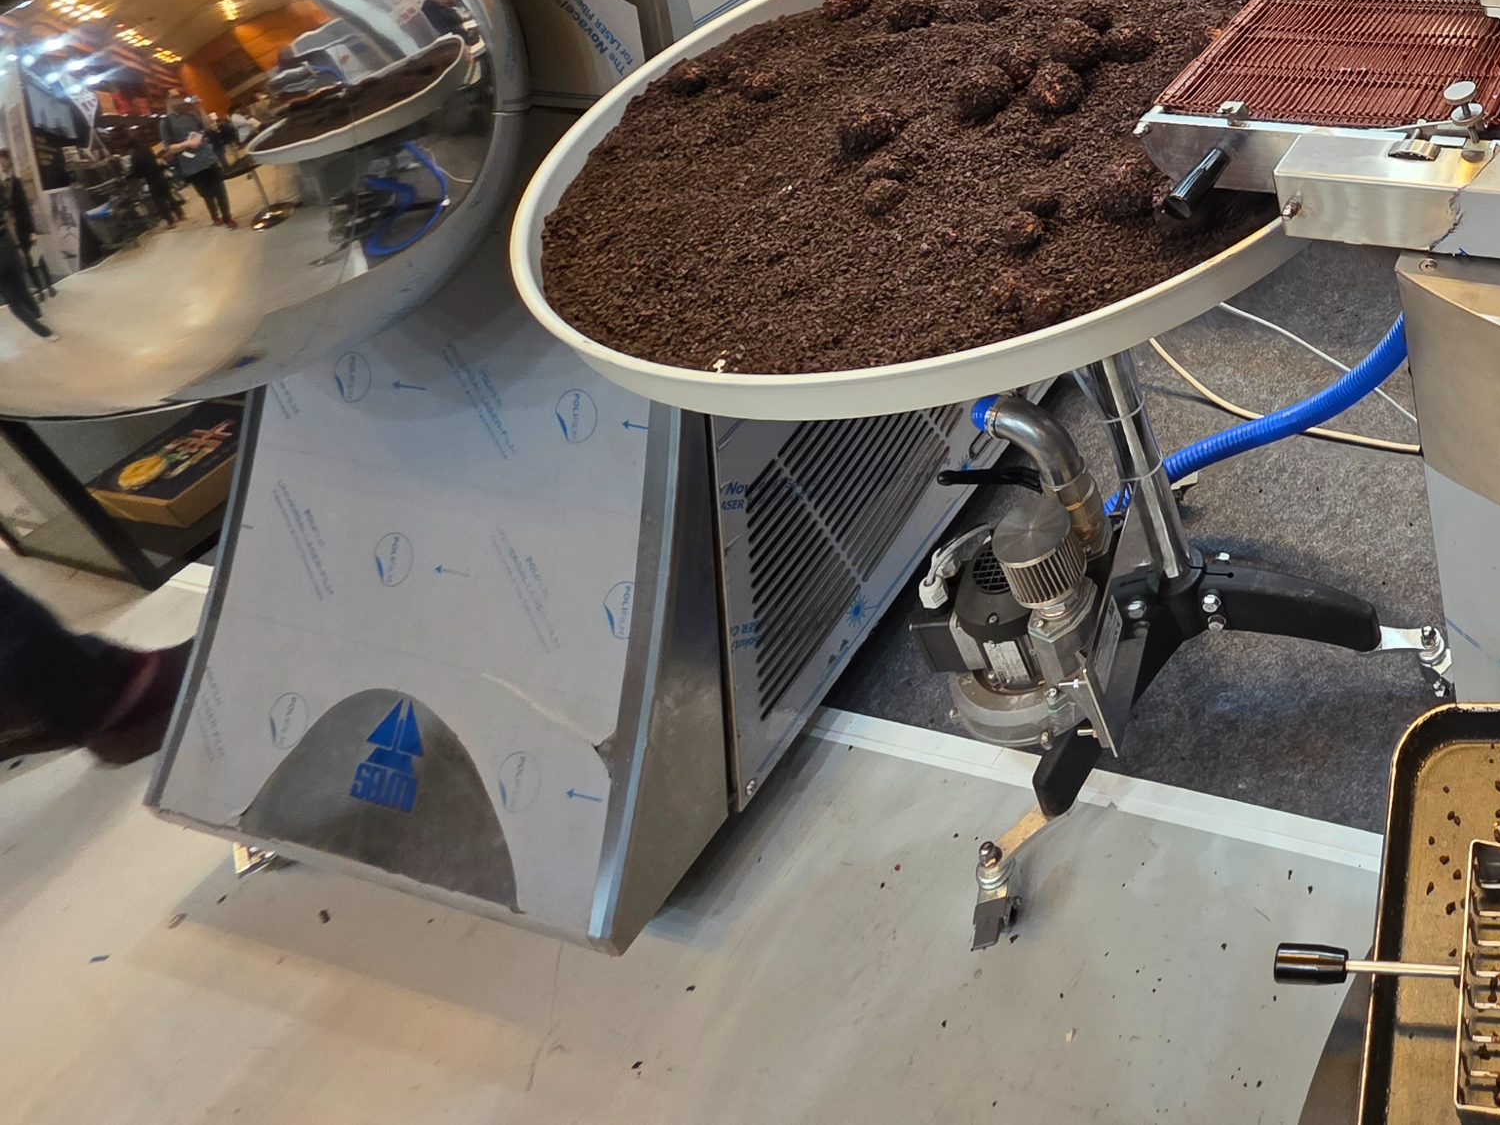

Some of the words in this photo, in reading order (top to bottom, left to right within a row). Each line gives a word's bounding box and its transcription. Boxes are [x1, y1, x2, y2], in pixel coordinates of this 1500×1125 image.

[595, 18, 621, 50] LASER
[609, 53, 626, 75] The
[620, 48, 633, 65] for
